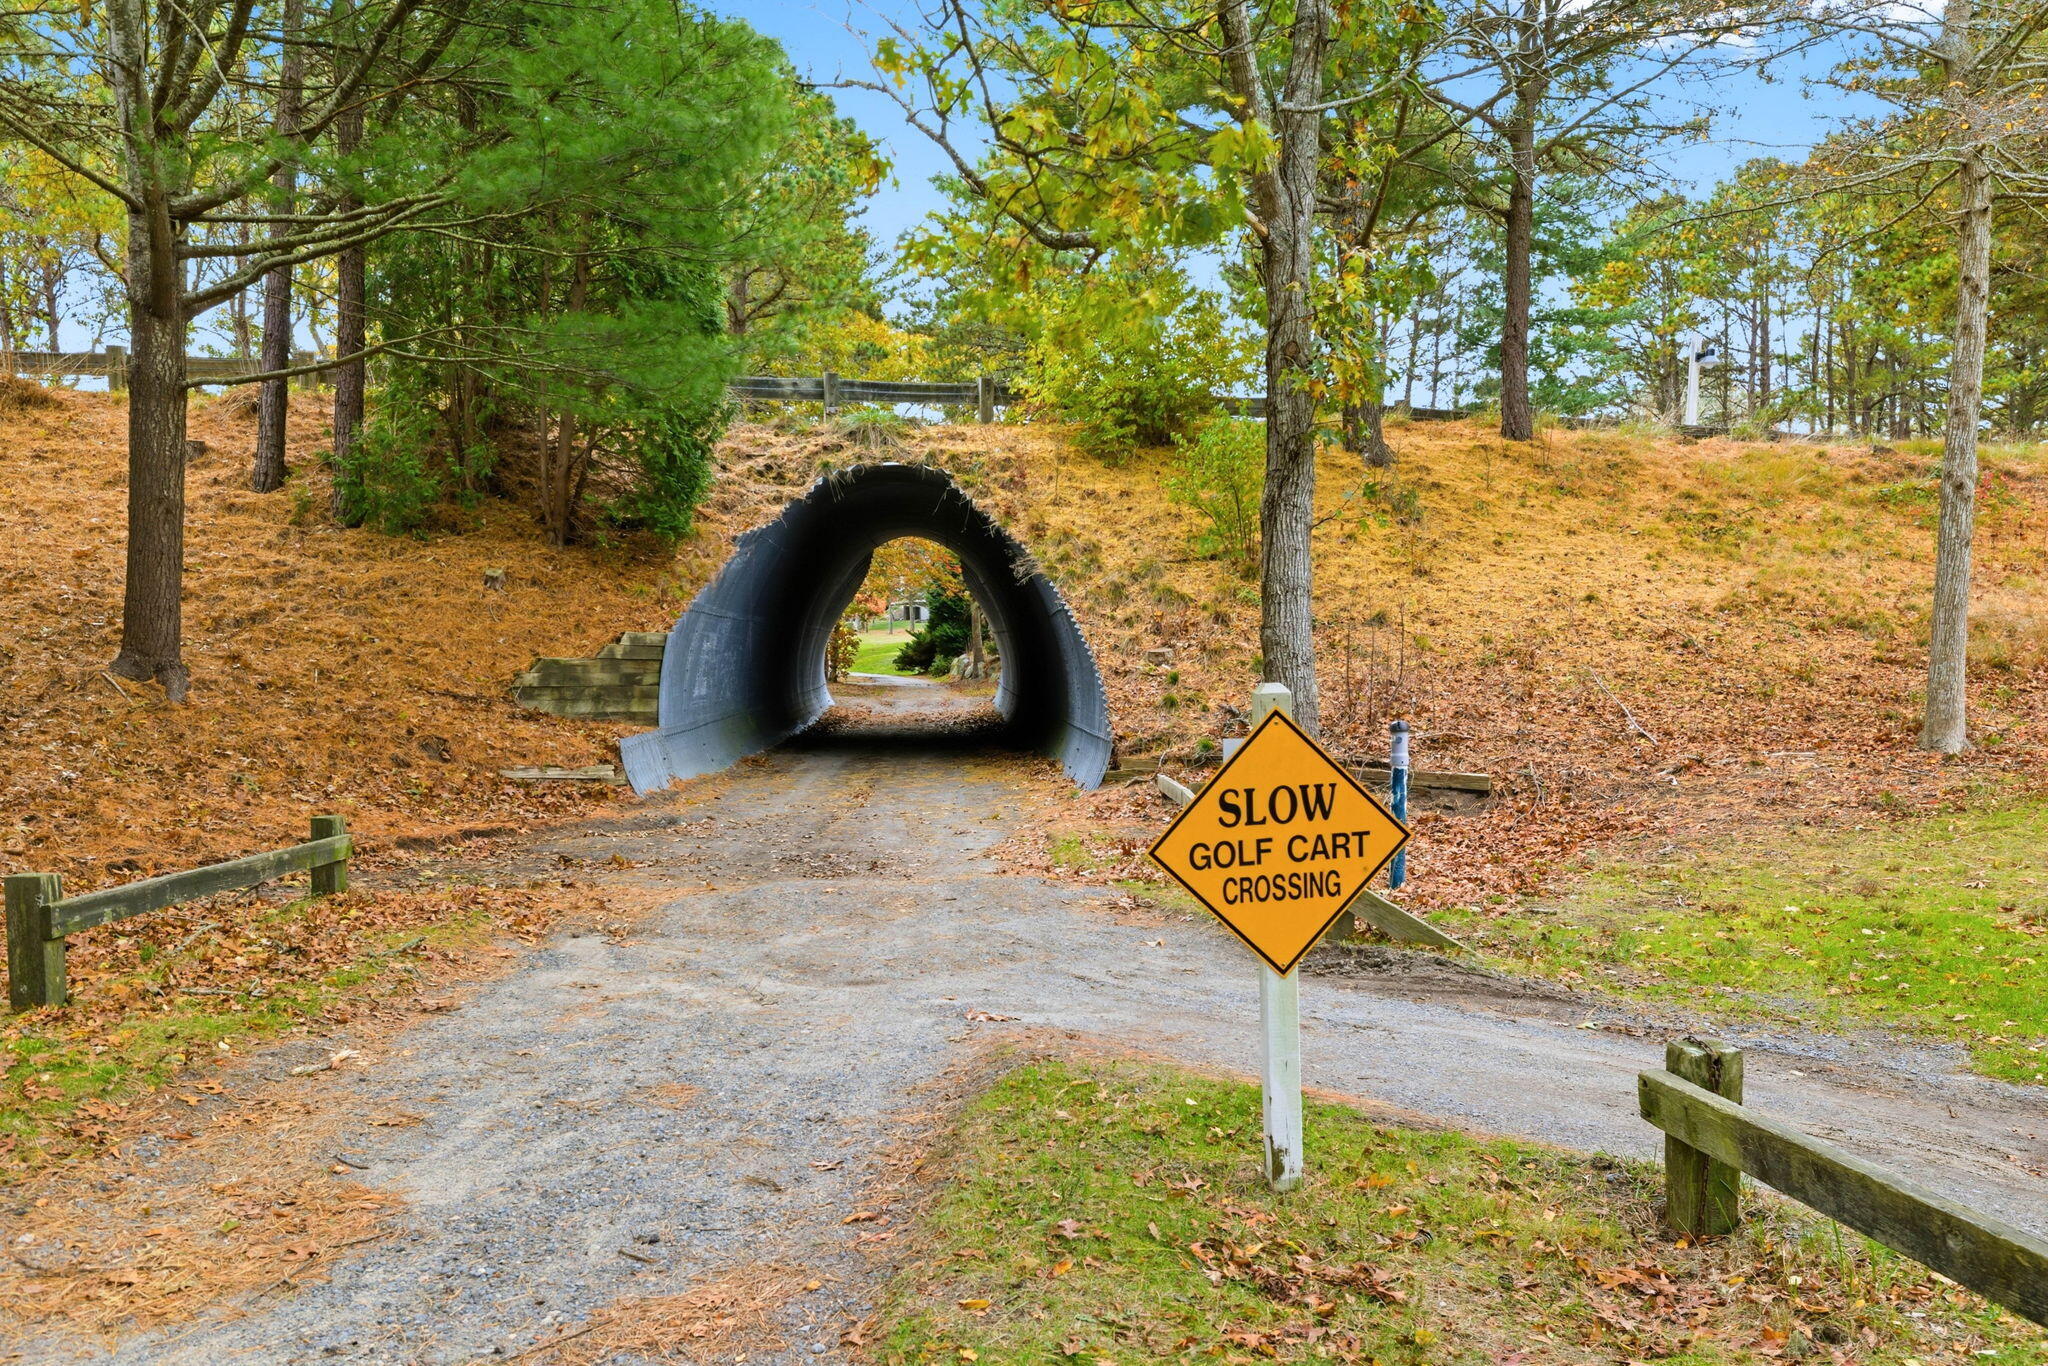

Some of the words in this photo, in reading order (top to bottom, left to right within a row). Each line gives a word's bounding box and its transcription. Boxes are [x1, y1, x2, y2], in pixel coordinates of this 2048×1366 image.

[1218, 782, 1337, 829] SLOW
[1189, 837, 1273, 871] GOLF
[1287, 830, 1371, 863] CART
[1222, 869, 1341, 906] CROSSING
